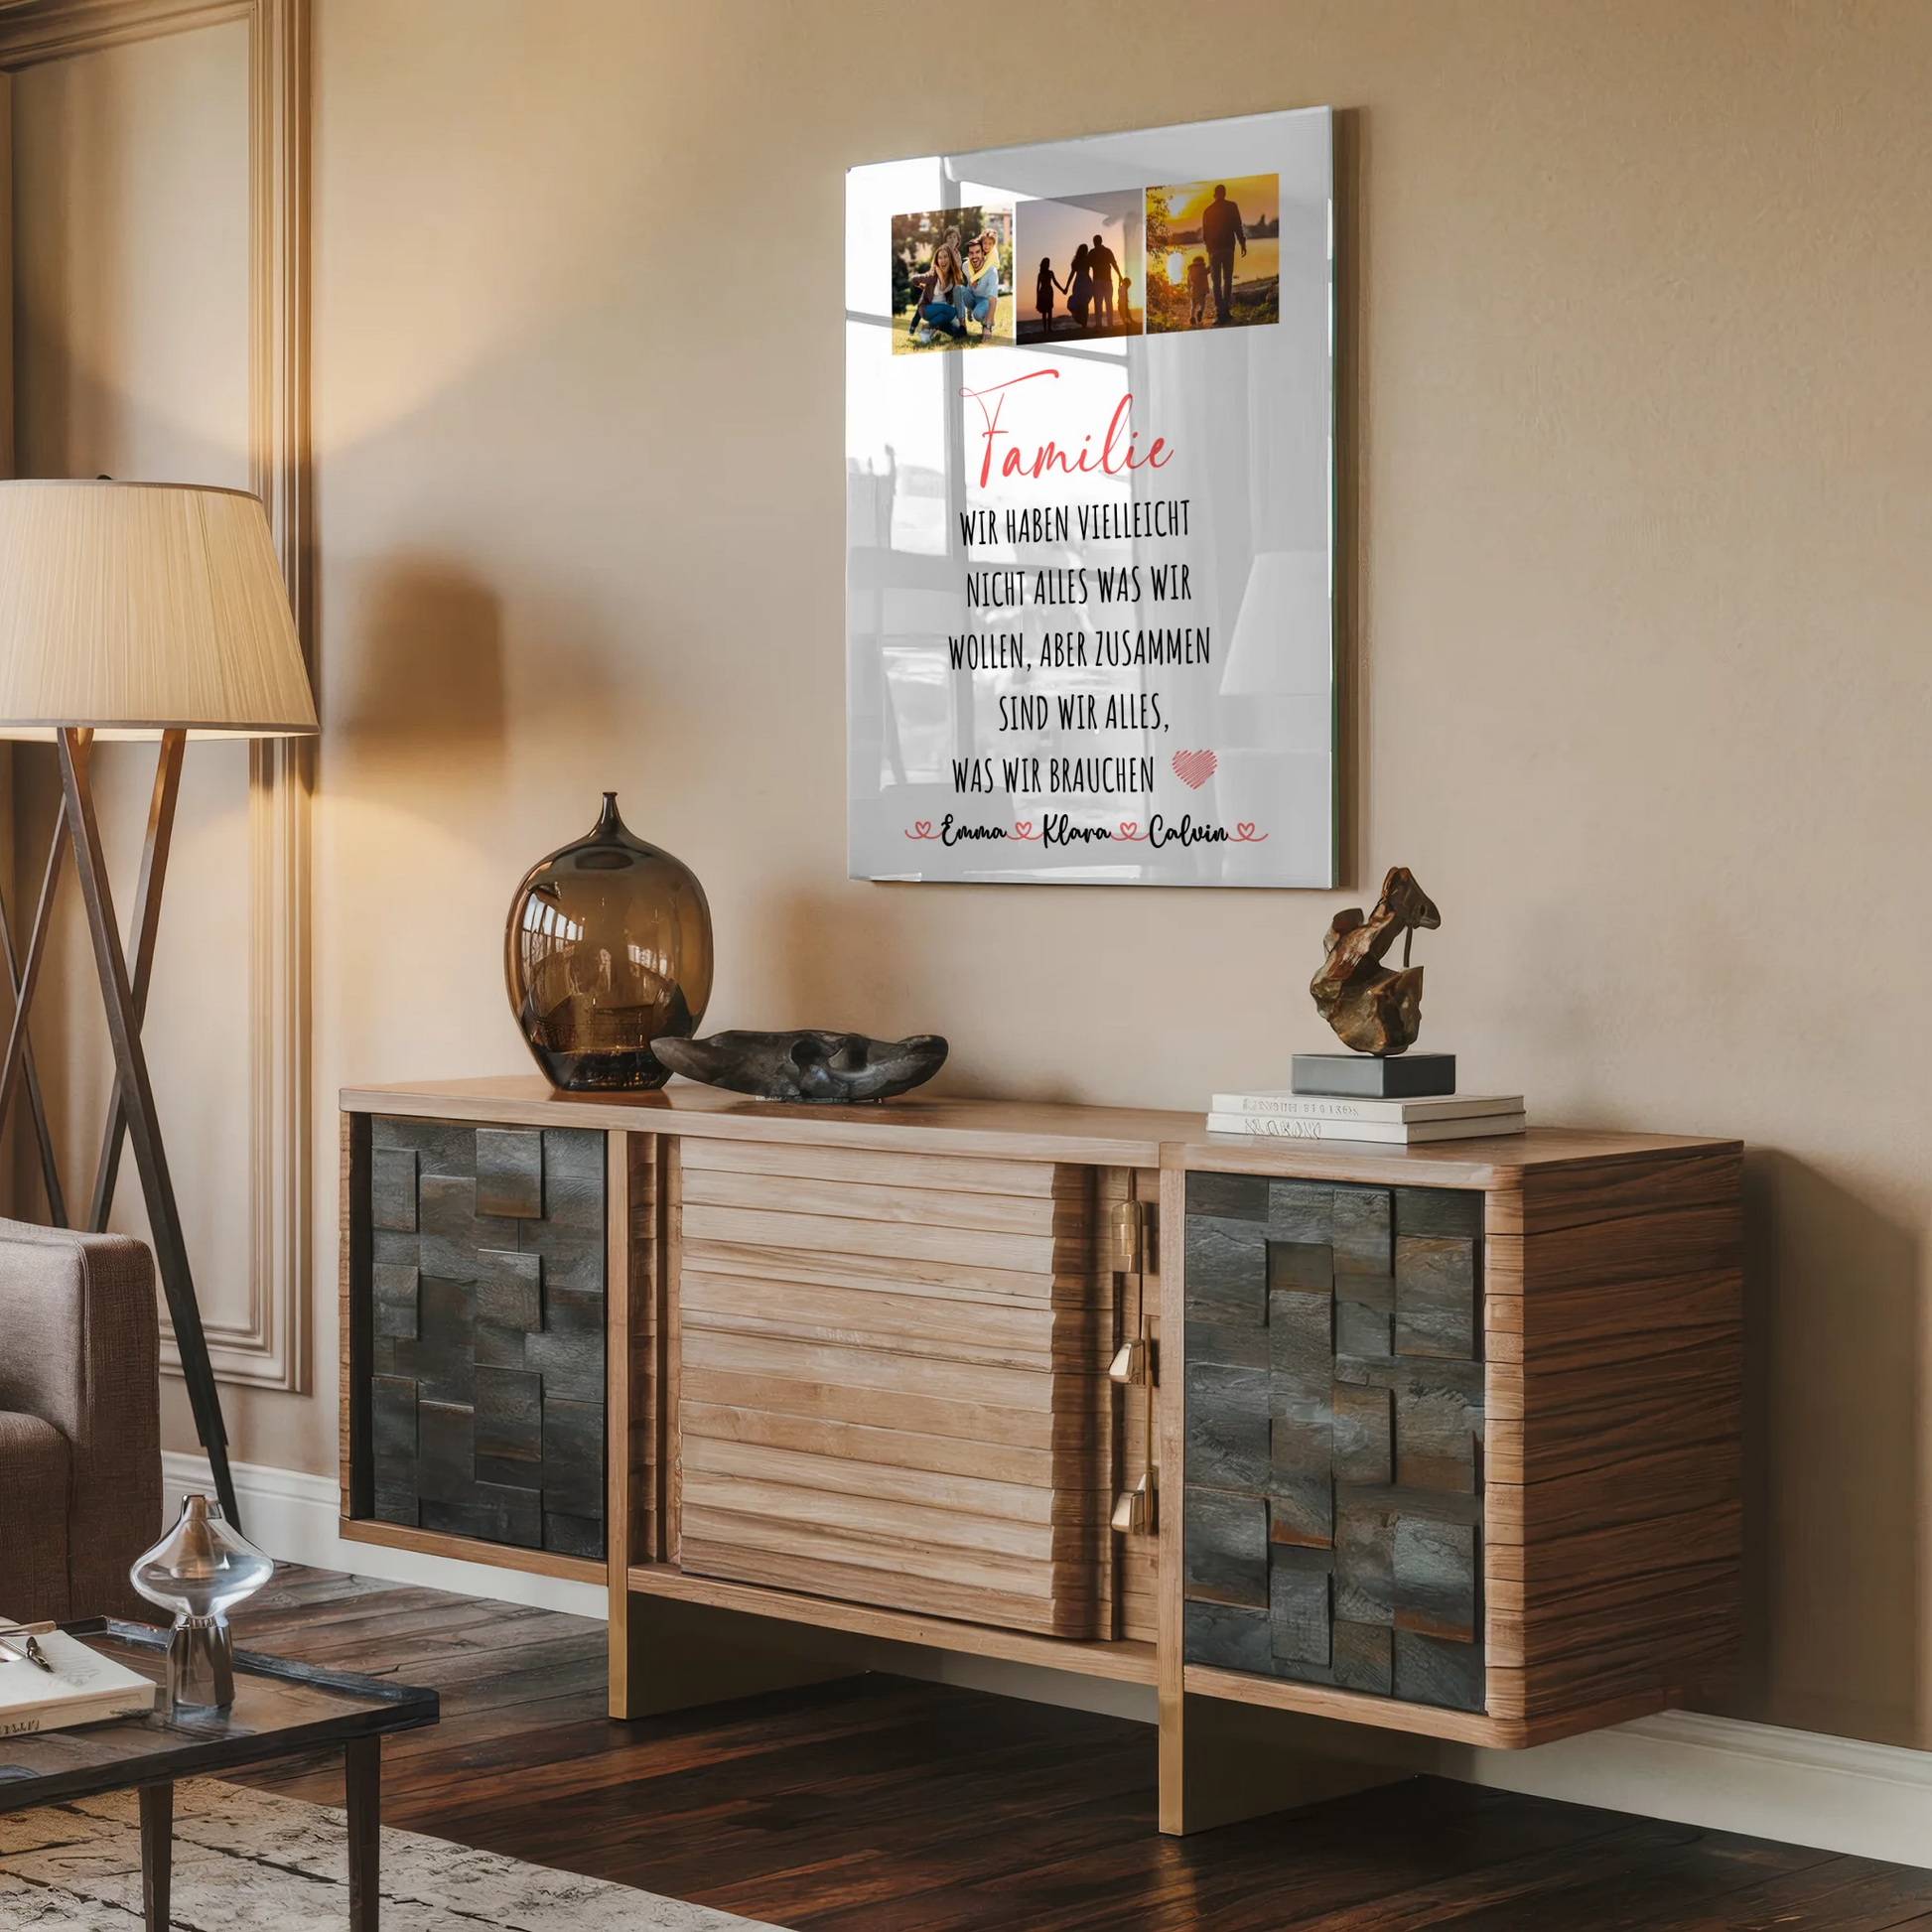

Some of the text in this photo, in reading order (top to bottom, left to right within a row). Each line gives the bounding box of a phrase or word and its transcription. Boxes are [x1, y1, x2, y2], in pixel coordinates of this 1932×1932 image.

[958, 368, 1174, 488] Familie
[959, 499, 1190, 547] WIR HABEN VIELLEICHT
[967, 564, 1191, 608] NICHT ALLES WAS WIR
[948, 626, 1210, 672] WOLLEN, ABER ZUSAMMEN
[999, 692, 1170, 733] SIND WIR ALLES,
[952, 756, 1154, 794] WAS WIR BRAUCHEN
[940, 813, 1229, 849] Emma Klara Calvin
